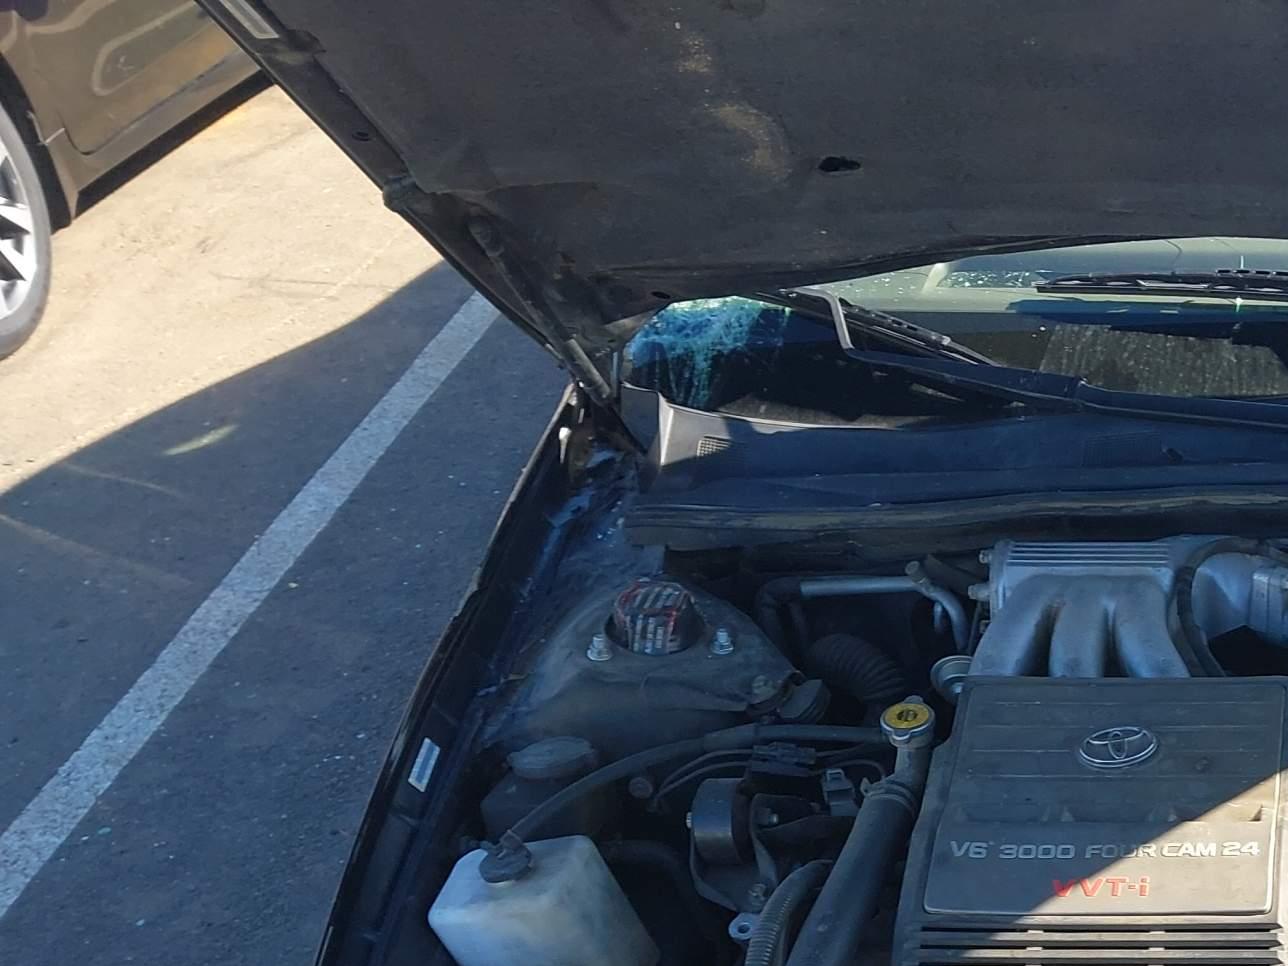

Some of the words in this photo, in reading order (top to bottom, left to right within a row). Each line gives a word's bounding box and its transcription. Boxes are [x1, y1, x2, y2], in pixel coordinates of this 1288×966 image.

[999, 843, 1077, 860] 3000
[1085, 844, 1159, 858] FOUR
[1161, 842, 1217, 858] CAM
[1221, 841, 1261, 857] 24
[1052, 876, 1152, 897] VVT-i
